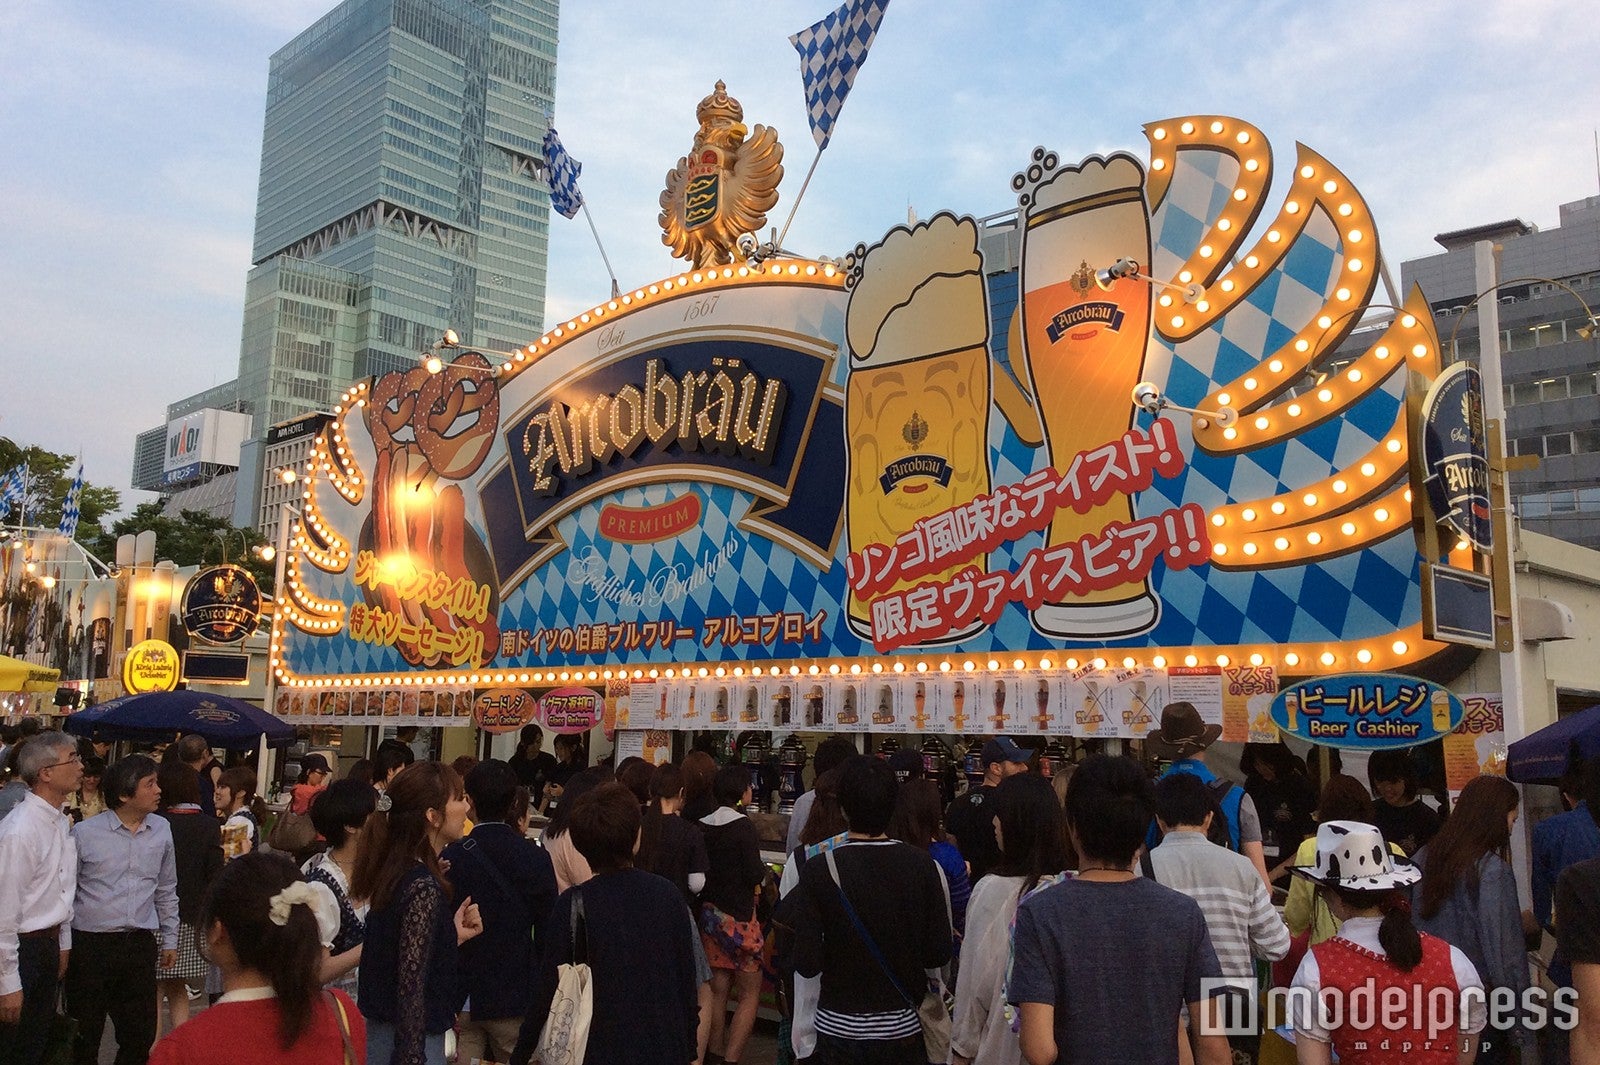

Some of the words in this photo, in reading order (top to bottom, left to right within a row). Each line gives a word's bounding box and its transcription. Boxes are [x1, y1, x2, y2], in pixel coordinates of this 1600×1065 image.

[597, 327, 626, 351] Seit
[682, 295, 720, 321] 1567
[1057, 304, 1111, 328] Arcobräu
[523, 357, 782, 491] Arcobräu
[889, 457, 940, 479] Arcobräu
[607, 504, 690, 534] PREMIUM
[847, 421, 1175, 590] リンゴ風味なテイスト!
[354, 552, 490, 622] ジャンスタイル!
[872, 510, 1202, 644] 限定ヴァイスビア!!
[349, 603, 483, 668] 特大ソーセージ!
[500, 620, 695, 658] 南ドイツの伯爵ブルワリー
[702, 609, 829, 648] アルコブロイ
[1224, 665, 1273, 683] マスで
[1228, 679, 1275, 696] のもう!!
[482, 694, 525, 713] フードレジ
[545, 694, 595, 713] グラス返却口
[1299, 684, 1428, 715] ビールレジ
[482, 715, 497, 726] Food
[499, 714, 521, 726] Cashier
[548, 715, 565, 726] Glass
[566, 715, 590, 726] Return
[1309, 720, 1348, 737] Beer
[1355, 718, 1420, 737] Cashier
